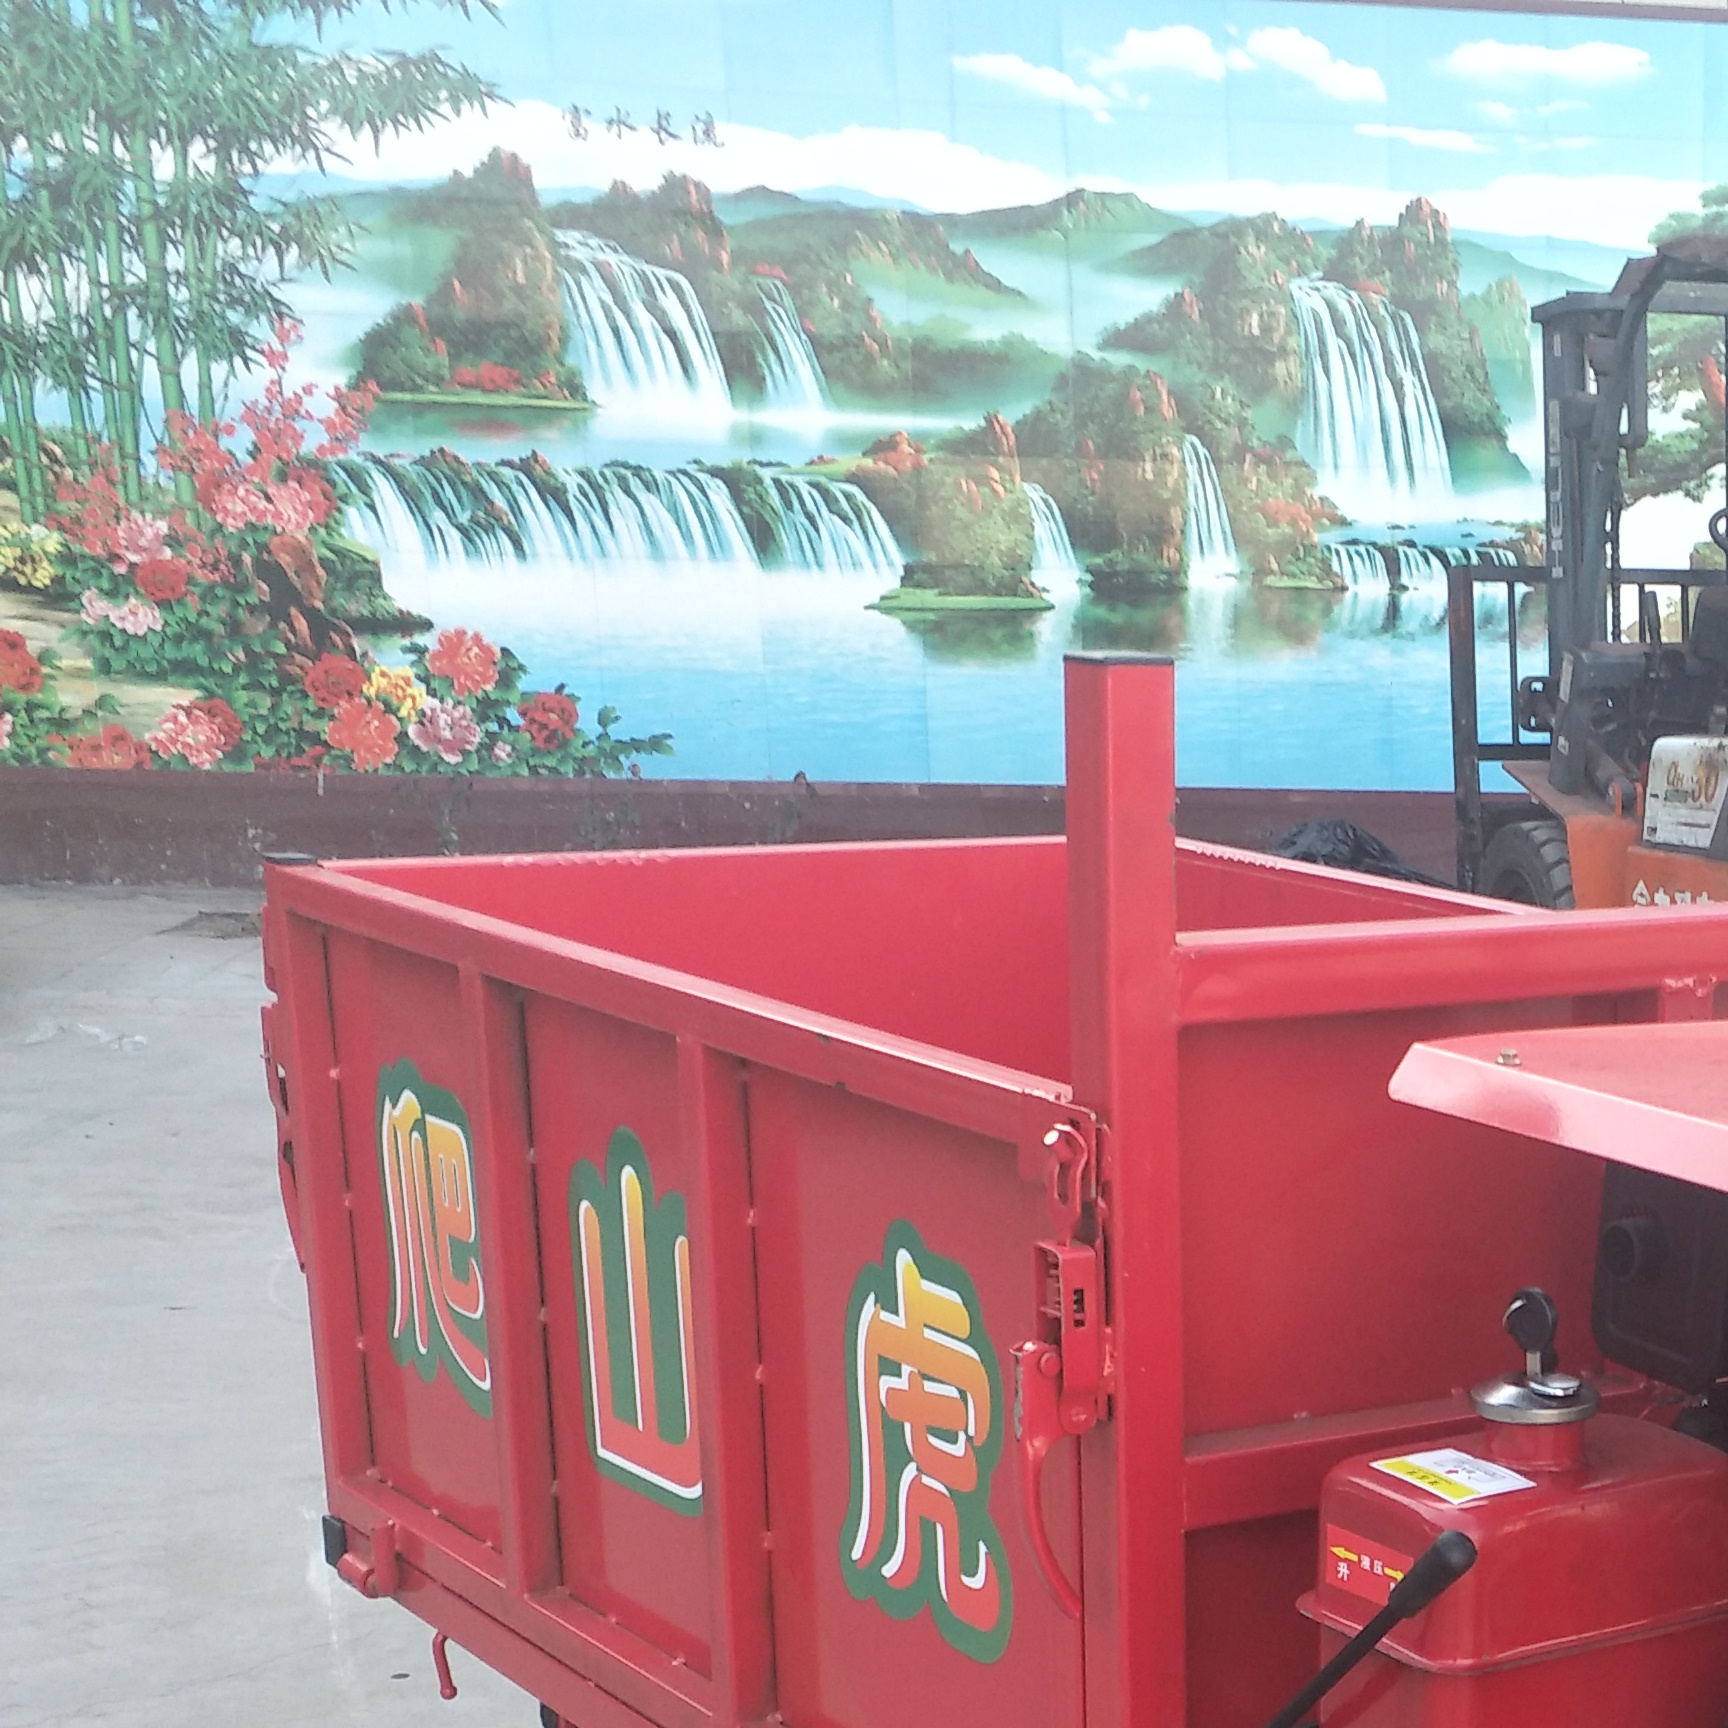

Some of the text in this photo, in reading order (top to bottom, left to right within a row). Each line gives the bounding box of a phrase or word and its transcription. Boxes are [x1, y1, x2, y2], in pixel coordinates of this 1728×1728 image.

[379, 1082, 998, 1638] 爬山虎
[1336, 1561, 1351, 1582] 升
[1360, 1554, 1384, 1576] 液压
